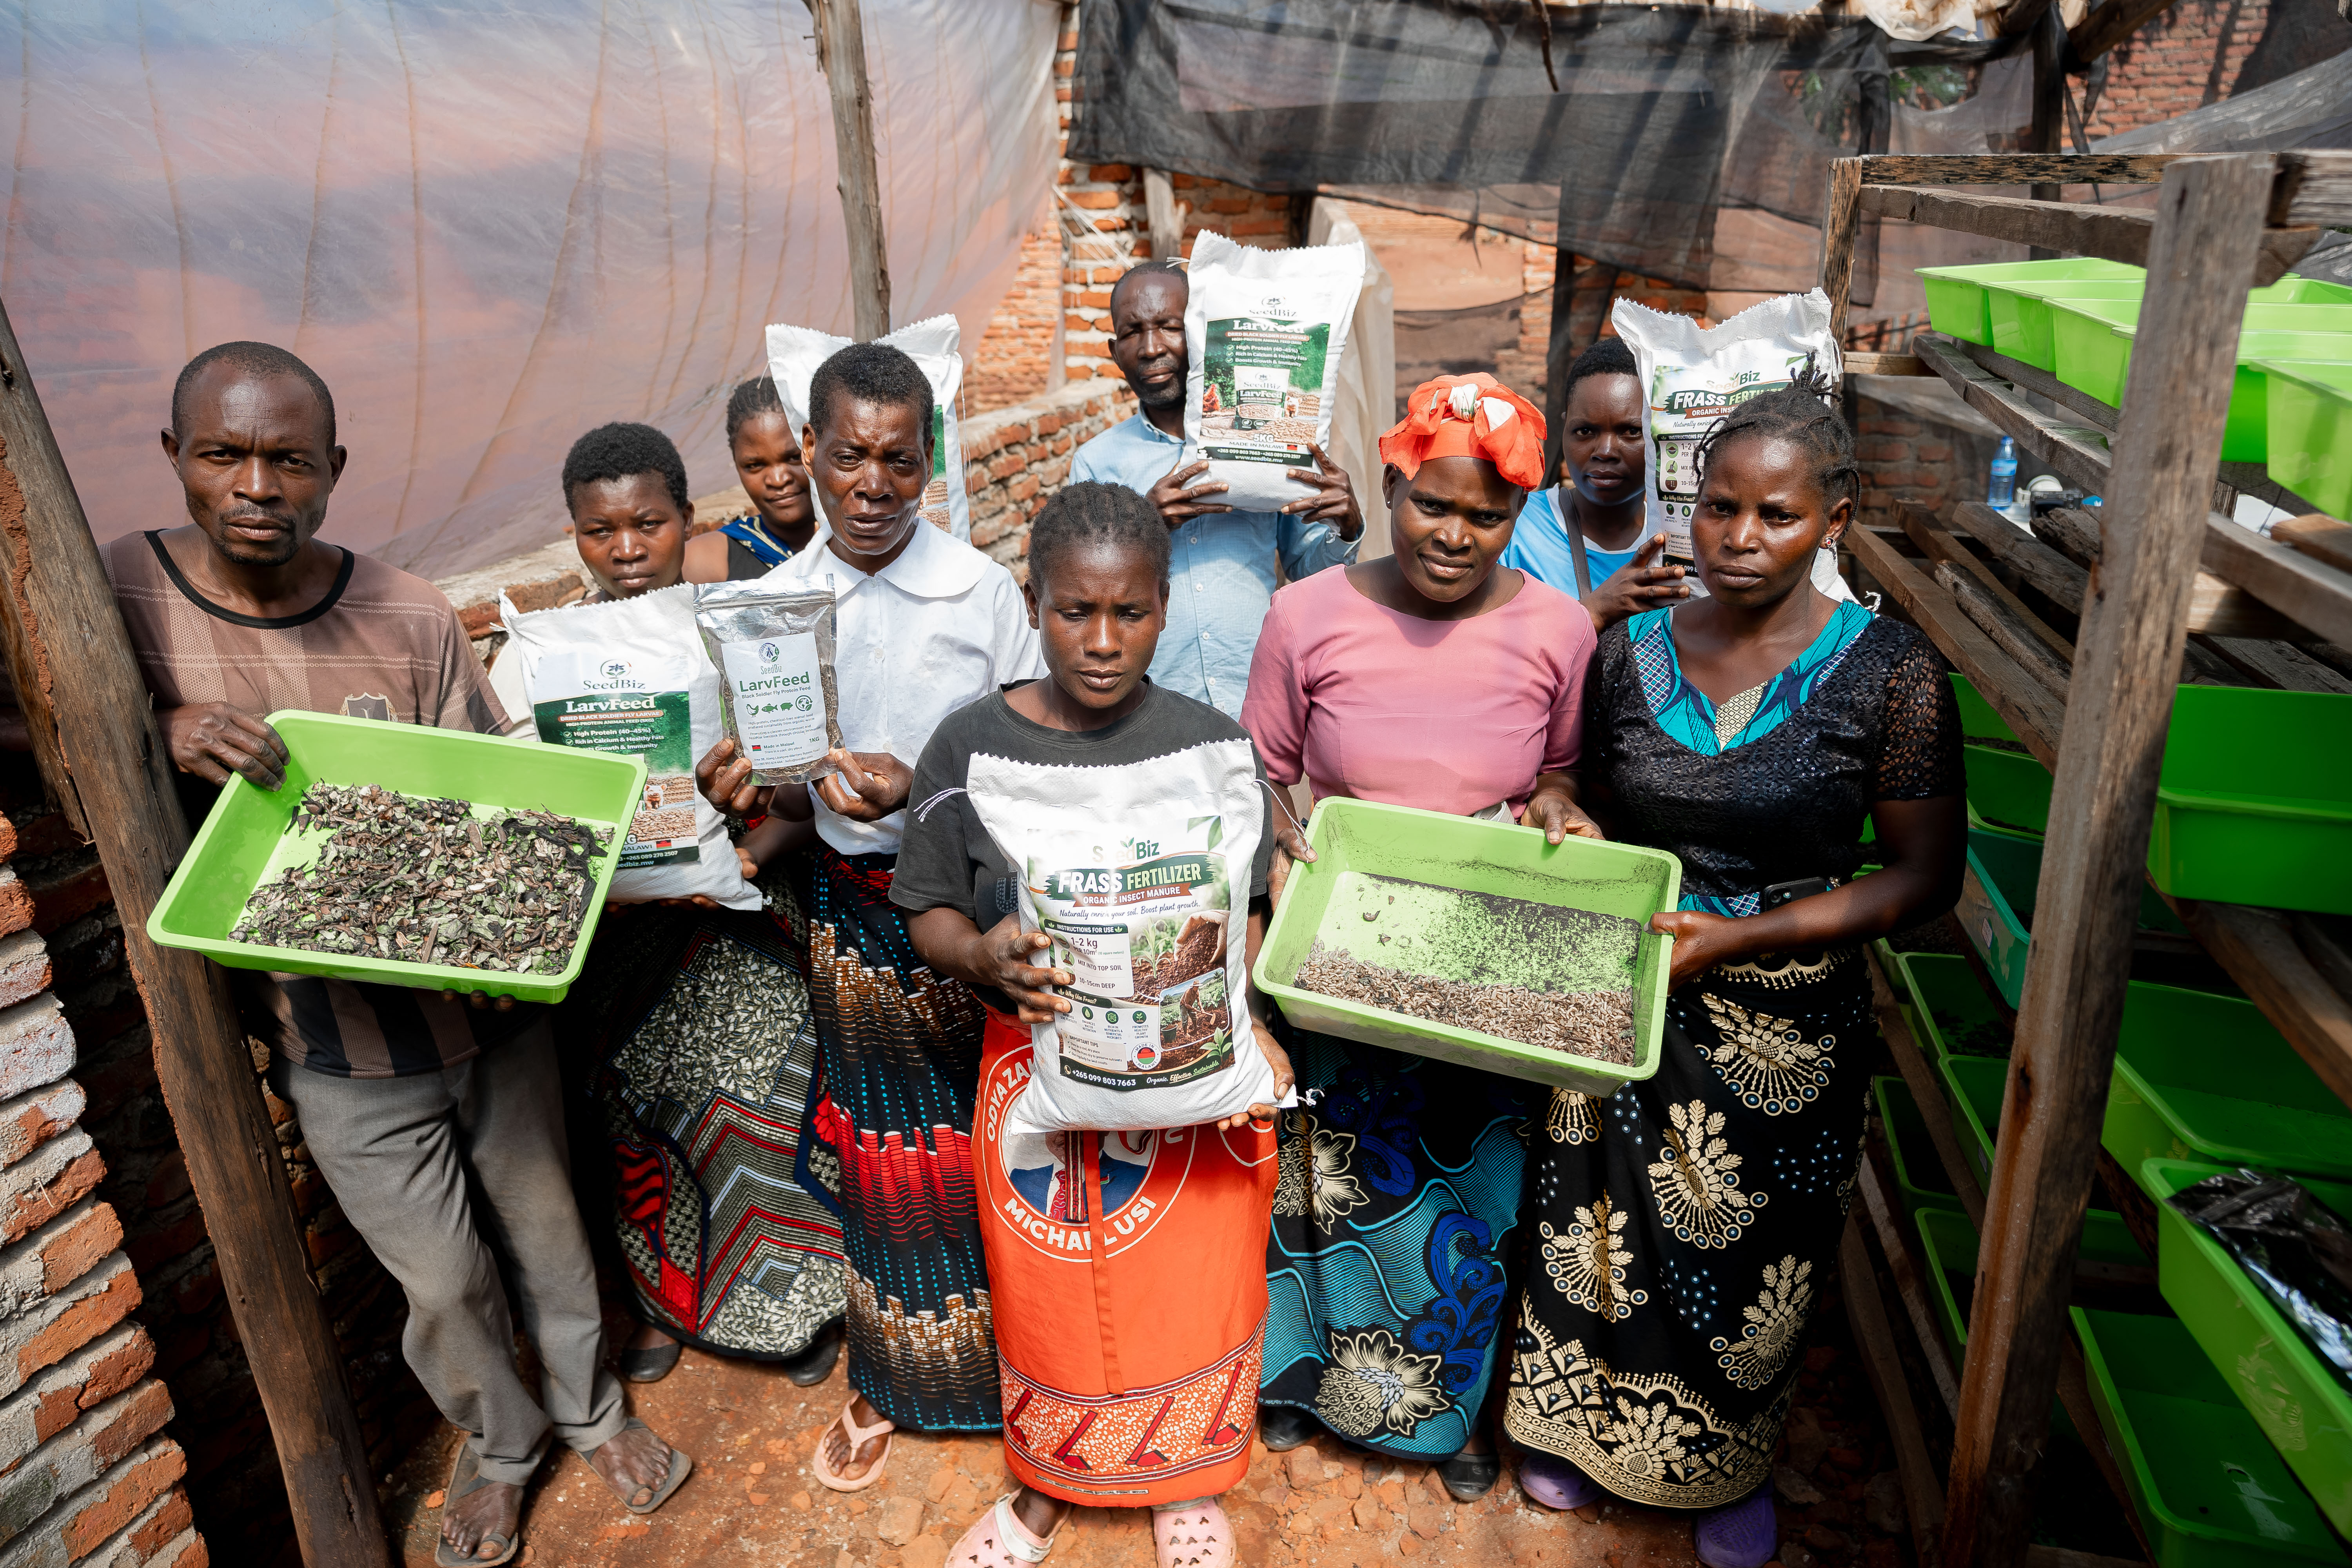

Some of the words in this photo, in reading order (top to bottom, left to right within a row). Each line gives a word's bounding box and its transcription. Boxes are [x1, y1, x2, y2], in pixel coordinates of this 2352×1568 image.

[1706, 371, 1760, 390] SeedBiz
[1240, 390, 1283, 399] LarvFeed
[1674, 392, 1726, 409] FRASS
[1692, 408, 1719, 416] ORGANIC
[1254, 434, 1274, 443] 5KG
[760, 664, 782, 675] SeedBiz
[583, 680, 646, 690] SeedBiz
[739, 671, 810, 692] LarvFeed
[566, 696, 656, 713] LarvFeed
[1093, 840, 1160, 862] SedBiz
[1058, 871, 1123, 893] FRASS
[1127, 863, 1202, 890] FERTILIZER
[1083, 894, 1118, 904] ORGANIC
[1119, 892, 1145, 904] INSECT
[1147, 886, 1181, 897] MANURE
[1060, 909, 1089, 920] Naturally
[1111, 911, 1125, 920] your
[1127, 908, 1138, 916] soil.
[1141, 905, 1158, 914] Boost
[1159, 902, 1175, 914] plant
[1177, 900, 1201, 912] growth.
[1057, 924, 1091, 933] INSTRUCTIONS
[1071, 937, 1084, 946] 1-2
[1087, 938, 1098, 949] kg
[1078, 959, 1086, 967] MIX
[1079, 977, 1100, 987] 10-15cm
[1065, 990, 1074, 1000] Why
[1069, 1035, 1089, 1045] IMPORTANT
[1137, 1061, 1157, 1069] MALAWI
[1072, 1070, 1087, 1080] +265
[1088, 1074, 1102, 1082] 099
[1103, 1077, 1116, 1085] 803
[1146, 1077, 1169, 1085] Organic.
[1170, 1072, 1192, 1082] Effective.
[1193, 1060, 1220, 1075] Sustainable.
[987, 1081, 1008, 1142] ODYA
[1112, 1196, 1157, 1235] USI
